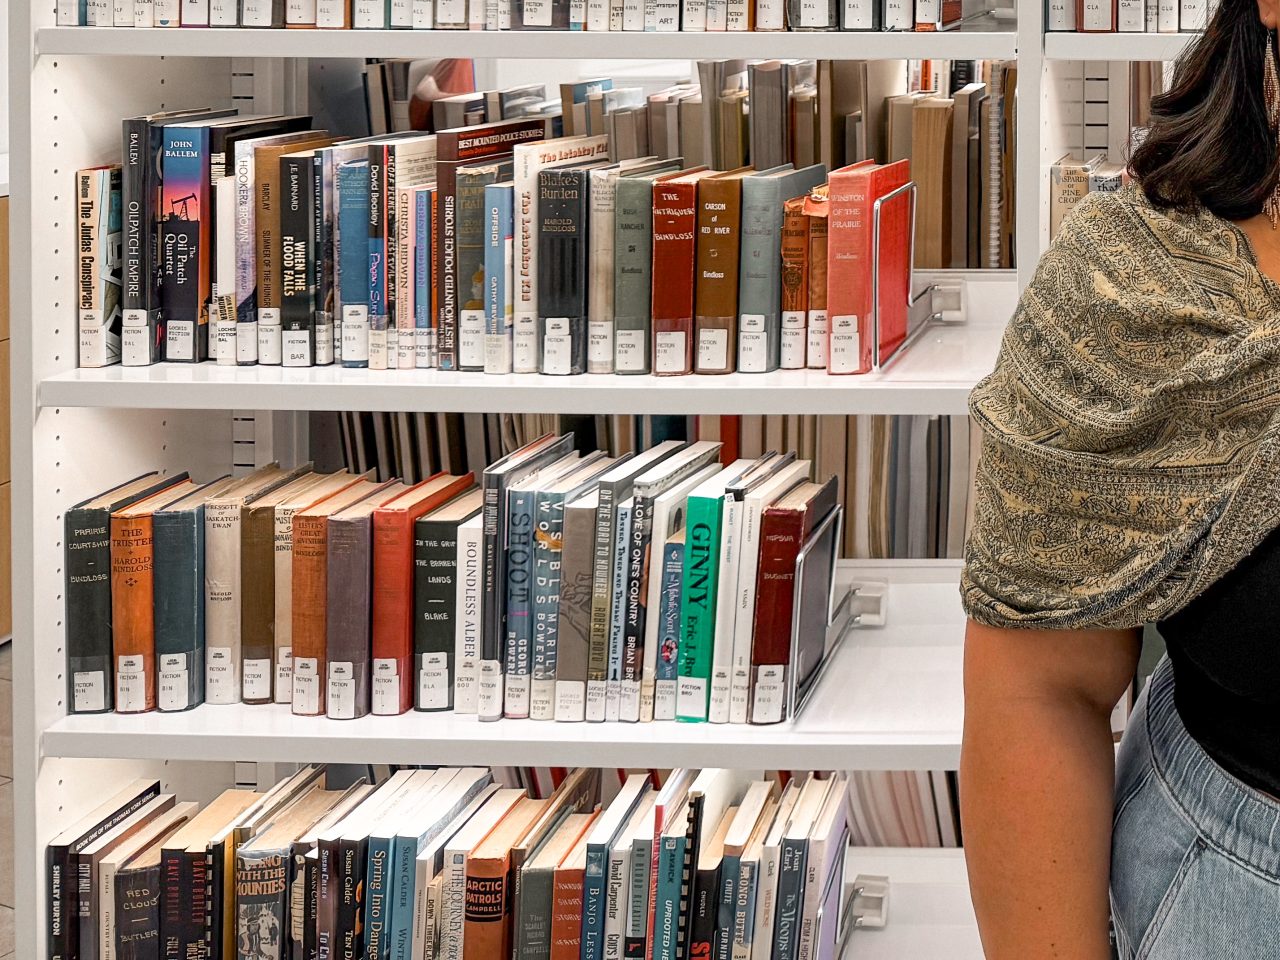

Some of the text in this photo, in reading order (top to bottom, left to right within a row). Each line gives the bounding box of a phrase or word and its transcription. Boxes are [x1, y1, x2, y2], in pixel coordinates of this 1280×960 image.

[81, 176, 90, 198] Ballem
[540, 172, 579, 185] Blake's
[370, 165, 379, 225] David Beasley
[541, 187, 578, 199] Burden
[662, 193, 679, 201] THE
[831, 194, 864, 202] WINSTON
[81, 201, 93, 218] The
[128, 133, 139, 297] BALLEM OILPATCH EMPIRE
[81, 221, 94, 252] Judas
[491, 207, 499, 247] OFFSIDE
[654, 232, 694, 240] BINDLOSS
[165, 234, 176, 275] Quartet
[177, 234, 188, 284] Oil Patch
[283, 237, 294, 296] FLOOD FALLS
[445, 195, 454, 348] BEST MOUNTED POLICE STORIES
[74, 527, 106, 536] PRAIRIE
[121, 529, 142, 537] THE
[536, 501, 550, 604] WORLDS
[548, 501, 563, 602] VISIBLE
[70, 574, 107, 583] BINDLOSS
[113, 563, 153, 573] BINDLOSS
[428, 576, 451, 584] LANDS
[687, 522, 711, 640] GINNY Eric
[627, 505, 644, 664] LOVE OF ONES COUNTRY BRIAN
[465, 541, 477, 657] BOUNDLESS ALBER
[263, 868, 285, 879] THE
[344, 850, 354, 904] Susan Calder
[467, 881, 502, 891] ARCTIC
[52, 865, 60, 936] SHIRLEY BURTON
[450, 867, 464, 934] THE JOURNEY
[466, 893, 501, 904] PATROLS
[609, 860, 623, 919] David Carpenter
[724, 879, 733, 905] CHUTE
[123, 899, 158, 910] CLOUD
[367, 851, 386, 960] Spring Into Dange
[466, 904, 501, 912] CAMPBELL
[120, 930, 158, 942] BUTLER
[663, 899, 673, 947] UPROOTED
